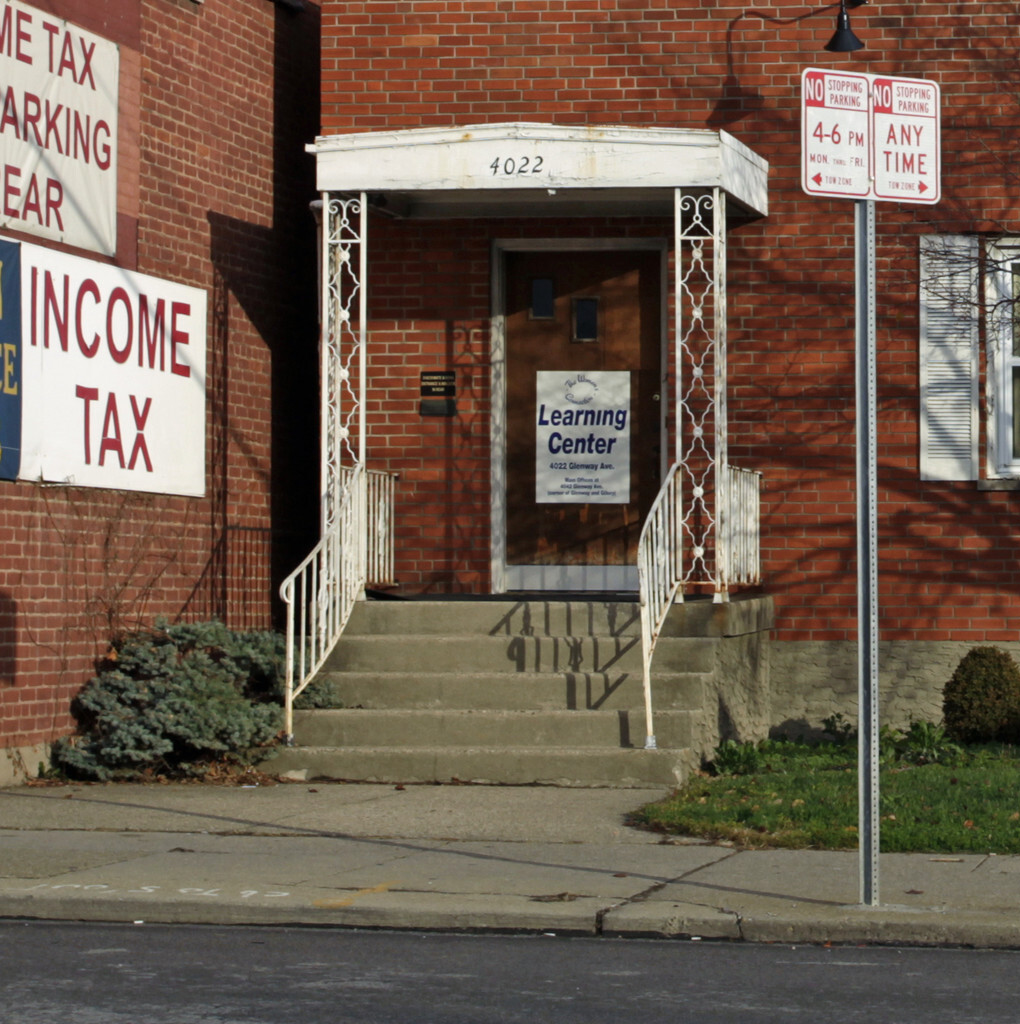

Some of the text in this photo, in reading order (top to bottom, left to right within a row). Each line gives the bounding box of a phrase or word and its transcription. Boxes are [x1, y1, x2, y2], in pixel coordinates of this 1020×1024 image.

[42, 20, 97, 91] TAX
[806, 77, 824, 101] NO
[828, 79, 863, 94] STOPPING
[873, 84, 892, 108] NO
[896, 85, 931, 100] STOPPING
[829, 93, 861, 108] PARKING
[898, 99, 930, 114] PARKING
[0, 85, 111, 171] ARKING
[812, 121, 865, 147] 4-6 PM
[886, 123, 924, 147] ANY
[490, 155, 544, 176] 4022
[883, 150, 928, 175] TIME
[825, 175, 853, 186] TOW ZONE
[888, 180, 916, 192] TOW ZONE
[3, 164, 65, 232] EAR
[30, 266, 192, 378] INCOME
[75, 384, 154, 473] TAX
[538, 404, 628, 431] Learning
[548, 432, 617, 455] Center
[549, 462, 615, 471] 4022 Glenway Ave.
